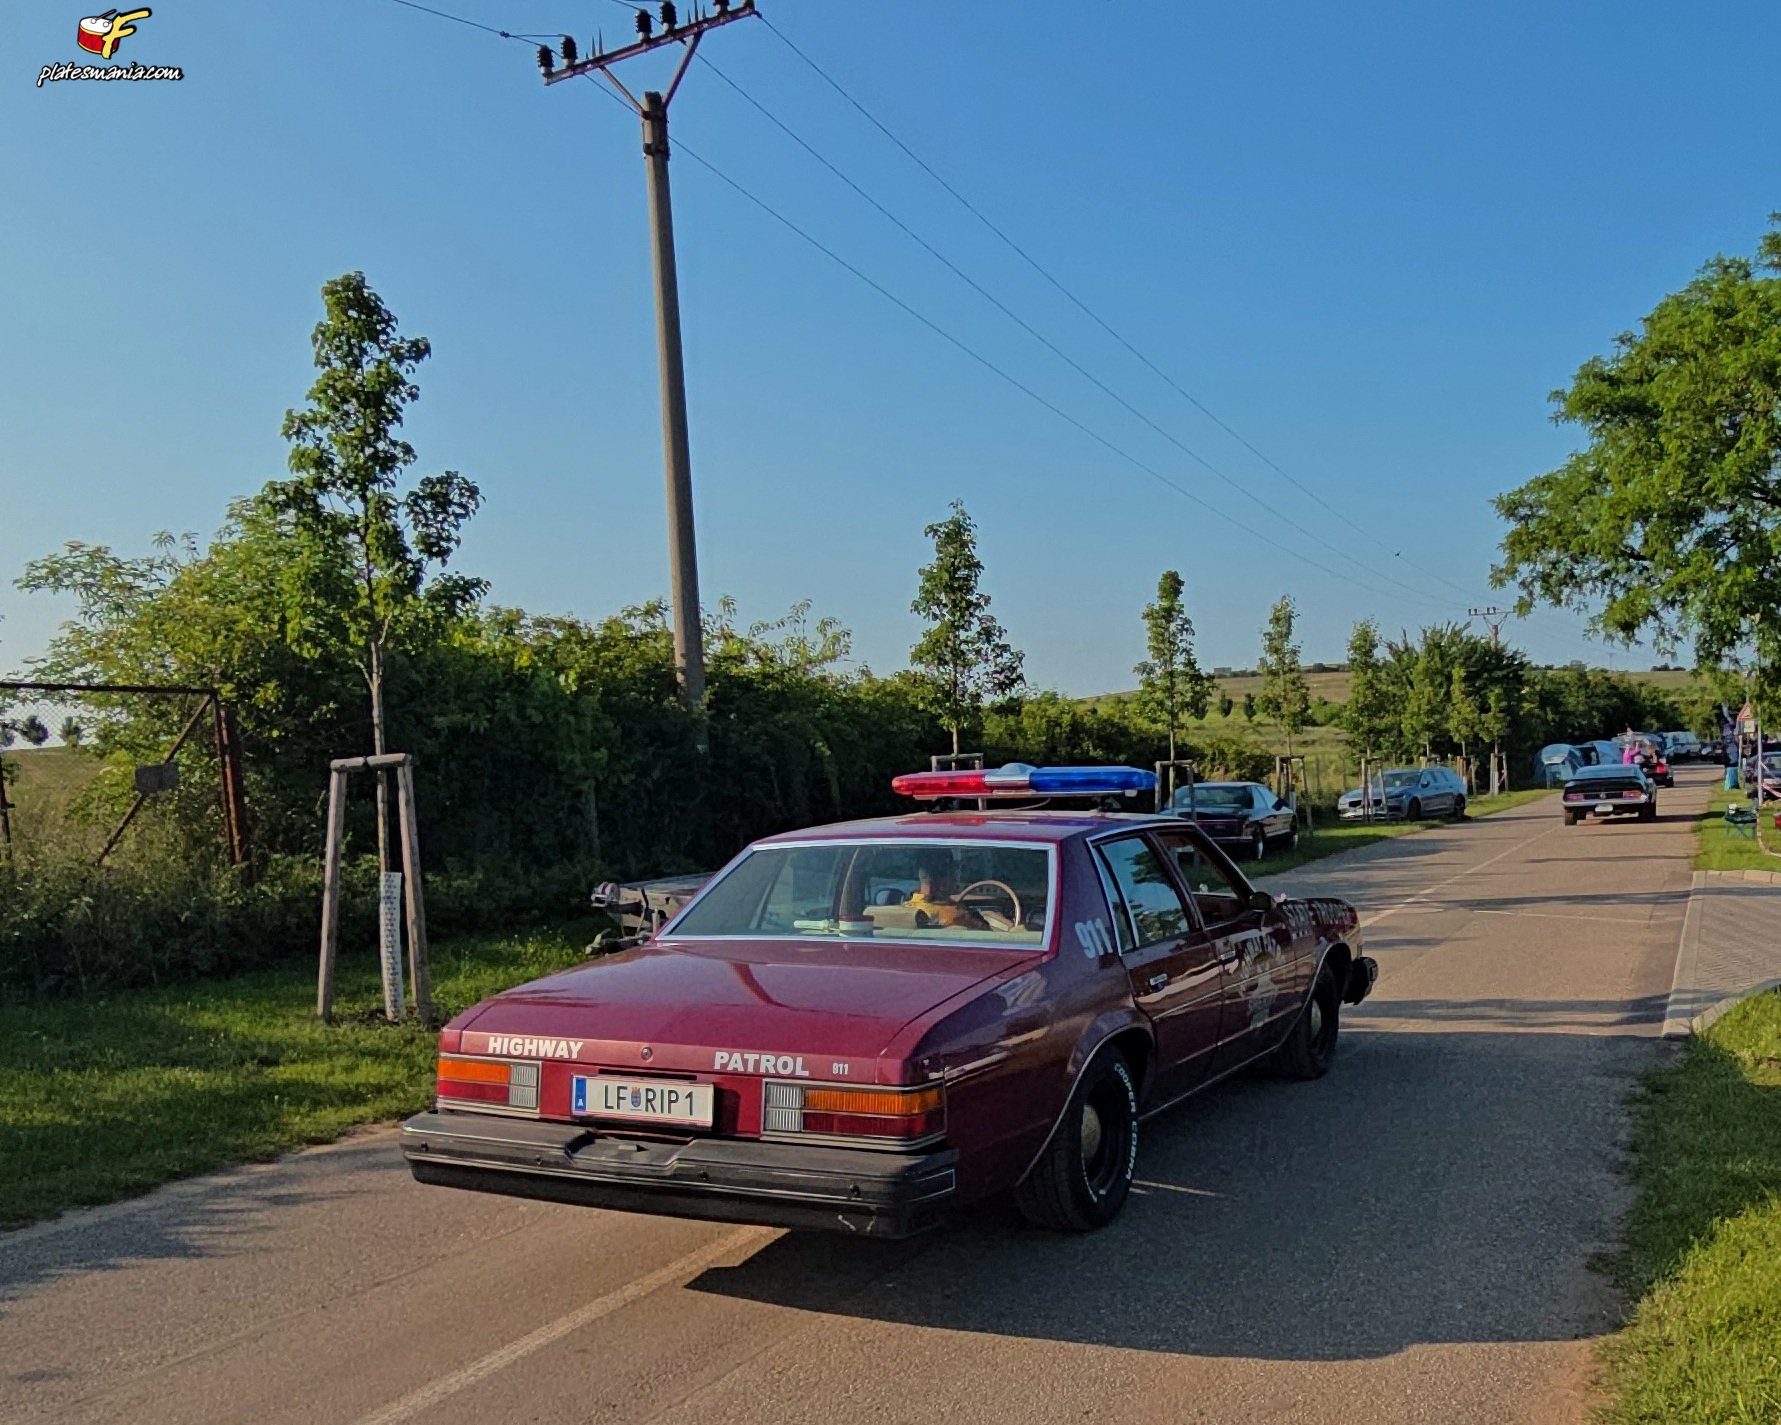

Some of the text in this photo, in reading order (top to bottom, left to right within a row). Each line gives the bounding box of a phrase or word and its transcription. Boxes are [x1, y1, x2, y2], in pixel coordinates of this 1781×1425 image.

[1074, 918, 1113, 959] 911
[487, 1036, 810, 1077] HIGHWAY PATROL
[832, 1062, 849, 1075] 911
[577, 1098, 584, 1107] A
[604, 1085, 628, 1110] LF
[1114, 1063, 1137, 1113] COOPER
